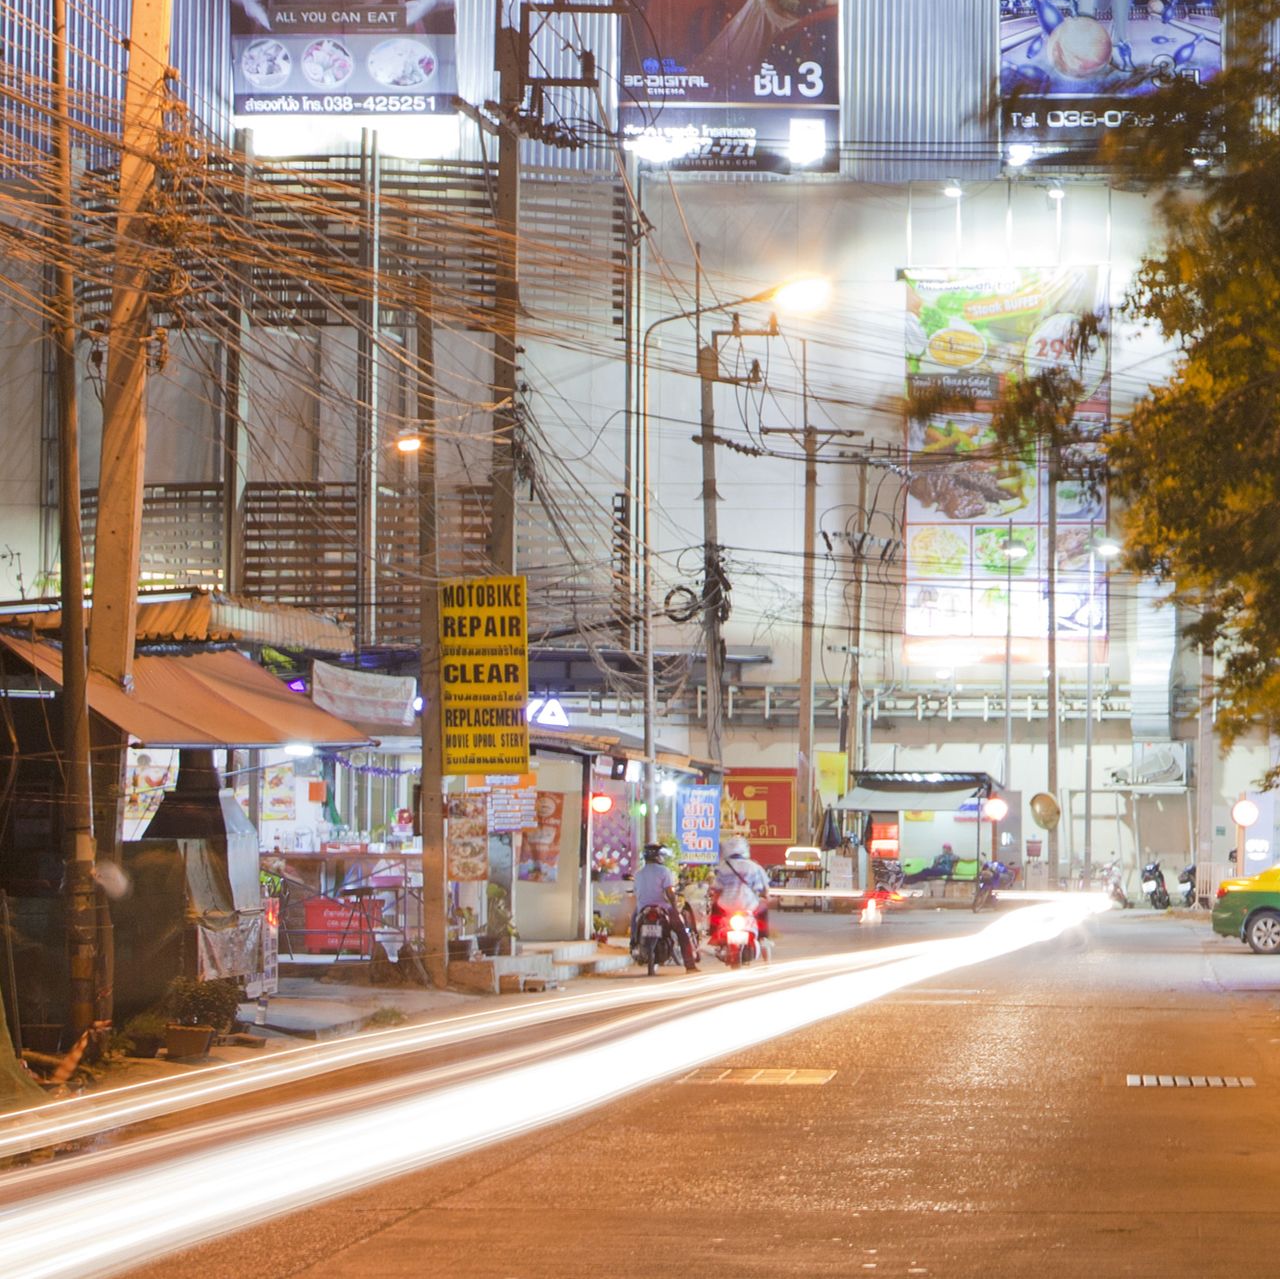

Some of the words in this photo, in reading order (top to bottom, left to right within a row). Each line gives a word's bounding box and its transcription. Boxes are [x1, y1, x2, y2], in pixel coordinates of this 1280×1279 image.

[275, 11, 297, 24] ALL
[301, 11, 327, 23] YOU
[332, 11, 360, 23] CAN
[368, 11, 398, 23] EAT
[754, 63, 791, 97] ชั้น
[798, 61, 824, 98] 3
[443, 584, 521, 607] MOTOBIKE
[443, 616, 521, 637] REPAIR
[444, 664, 519, 684] CLEAR
[445, 708, 525, 727] REPLACEMENT
